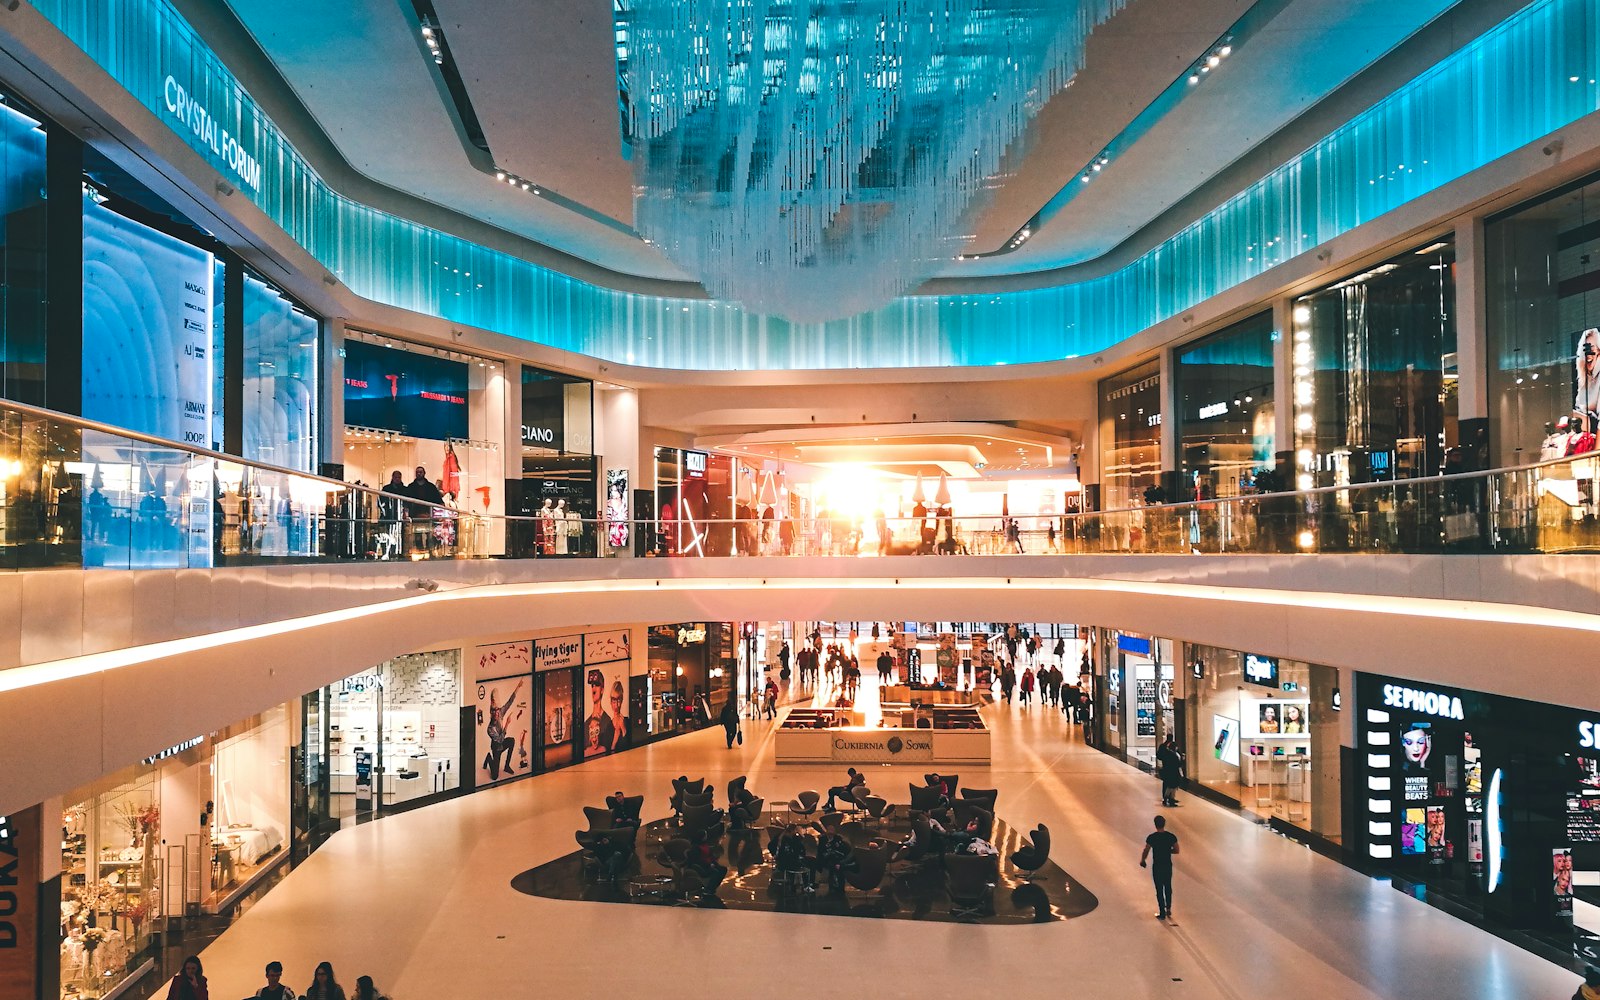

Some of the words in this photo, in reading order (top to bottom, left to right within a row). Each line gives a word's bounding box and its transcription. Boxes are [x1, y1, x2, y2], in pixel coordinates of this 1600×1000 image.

[165, 75, 219, 155] CRYSTAL
[222, 129, 260, 193] FORUM
[351, 380, 368, 389] JEANS
[450, 396, 465, 405] JEANS
[184, 431, 205, 443] JOOP!
[520, 425, 553, 442] CIANO
[541, 486, 583, 494] MARIANO
[535, 644, 558, 660] flying
[559, 642, 579, 656] tiger
[543, 657, 571, 667] copenhagen
[1383, 683, 1465, 721] SEPHORA
[834, 738, 884, 750] CUKIERNIA
[905, 739, 931, 750] SOWA
[1404, 776, 1428, 784] WHERE
[1404, 792, 1429, 800] BEATS
